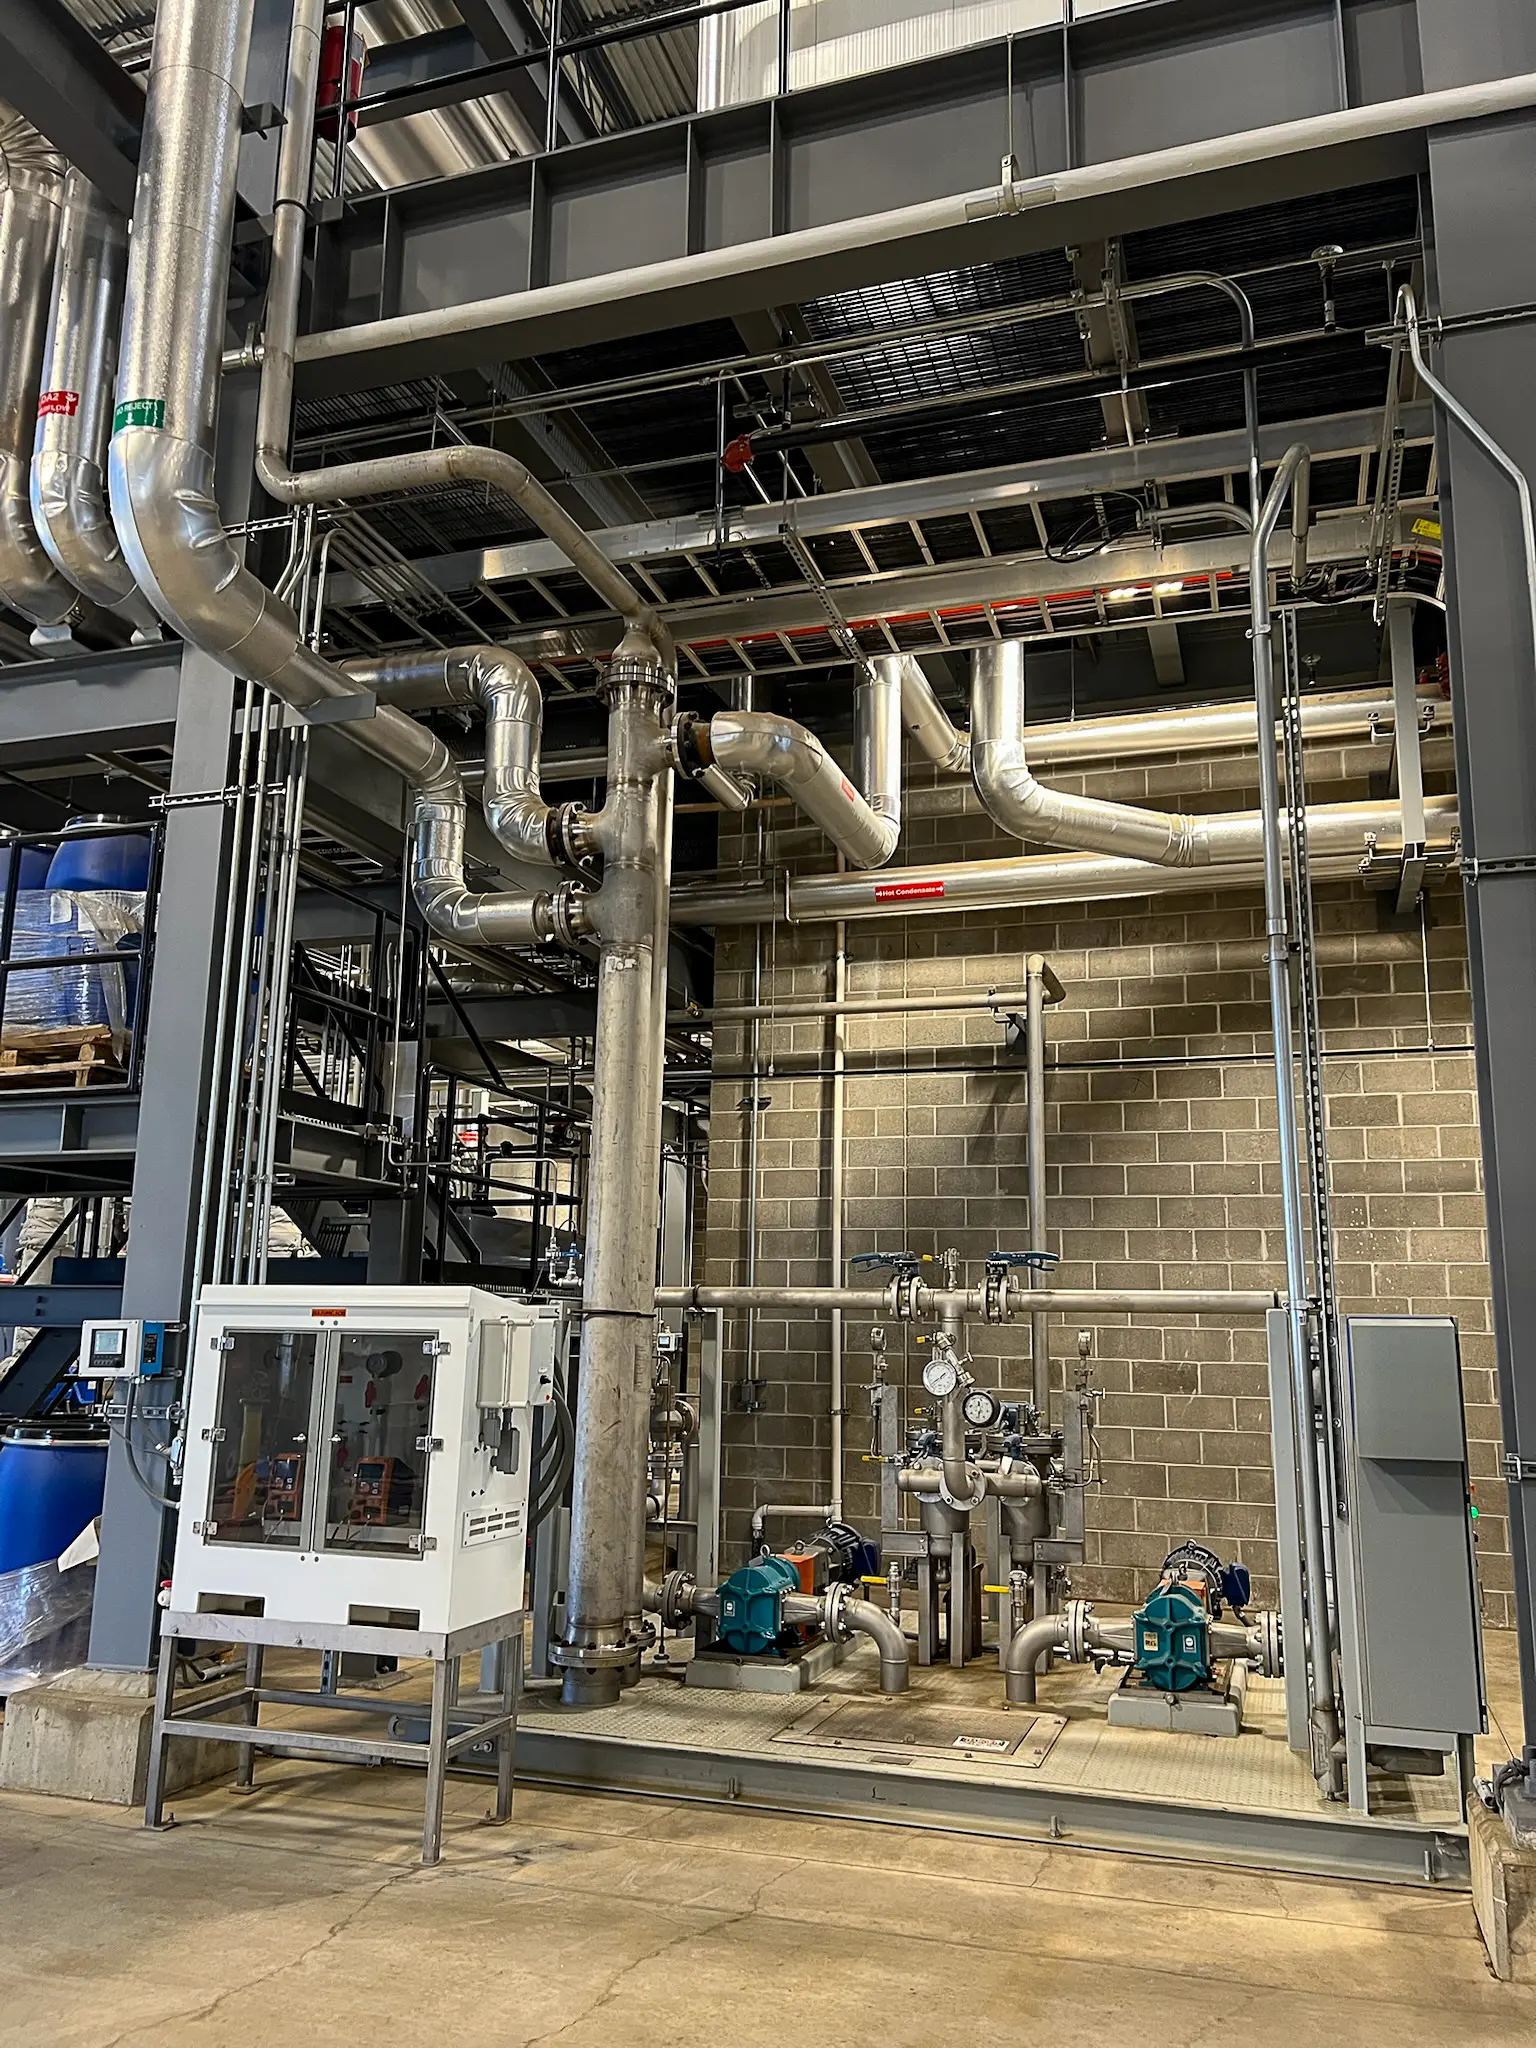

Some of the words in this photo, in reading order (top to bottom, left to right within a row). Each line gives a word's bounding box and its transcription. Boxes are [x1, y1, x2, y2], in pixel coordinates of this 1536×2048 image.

[124, 401, 153, 412] REJECT
[882, 889, 895, 897] Hot
[895, 886, 936, 896] Condensate
